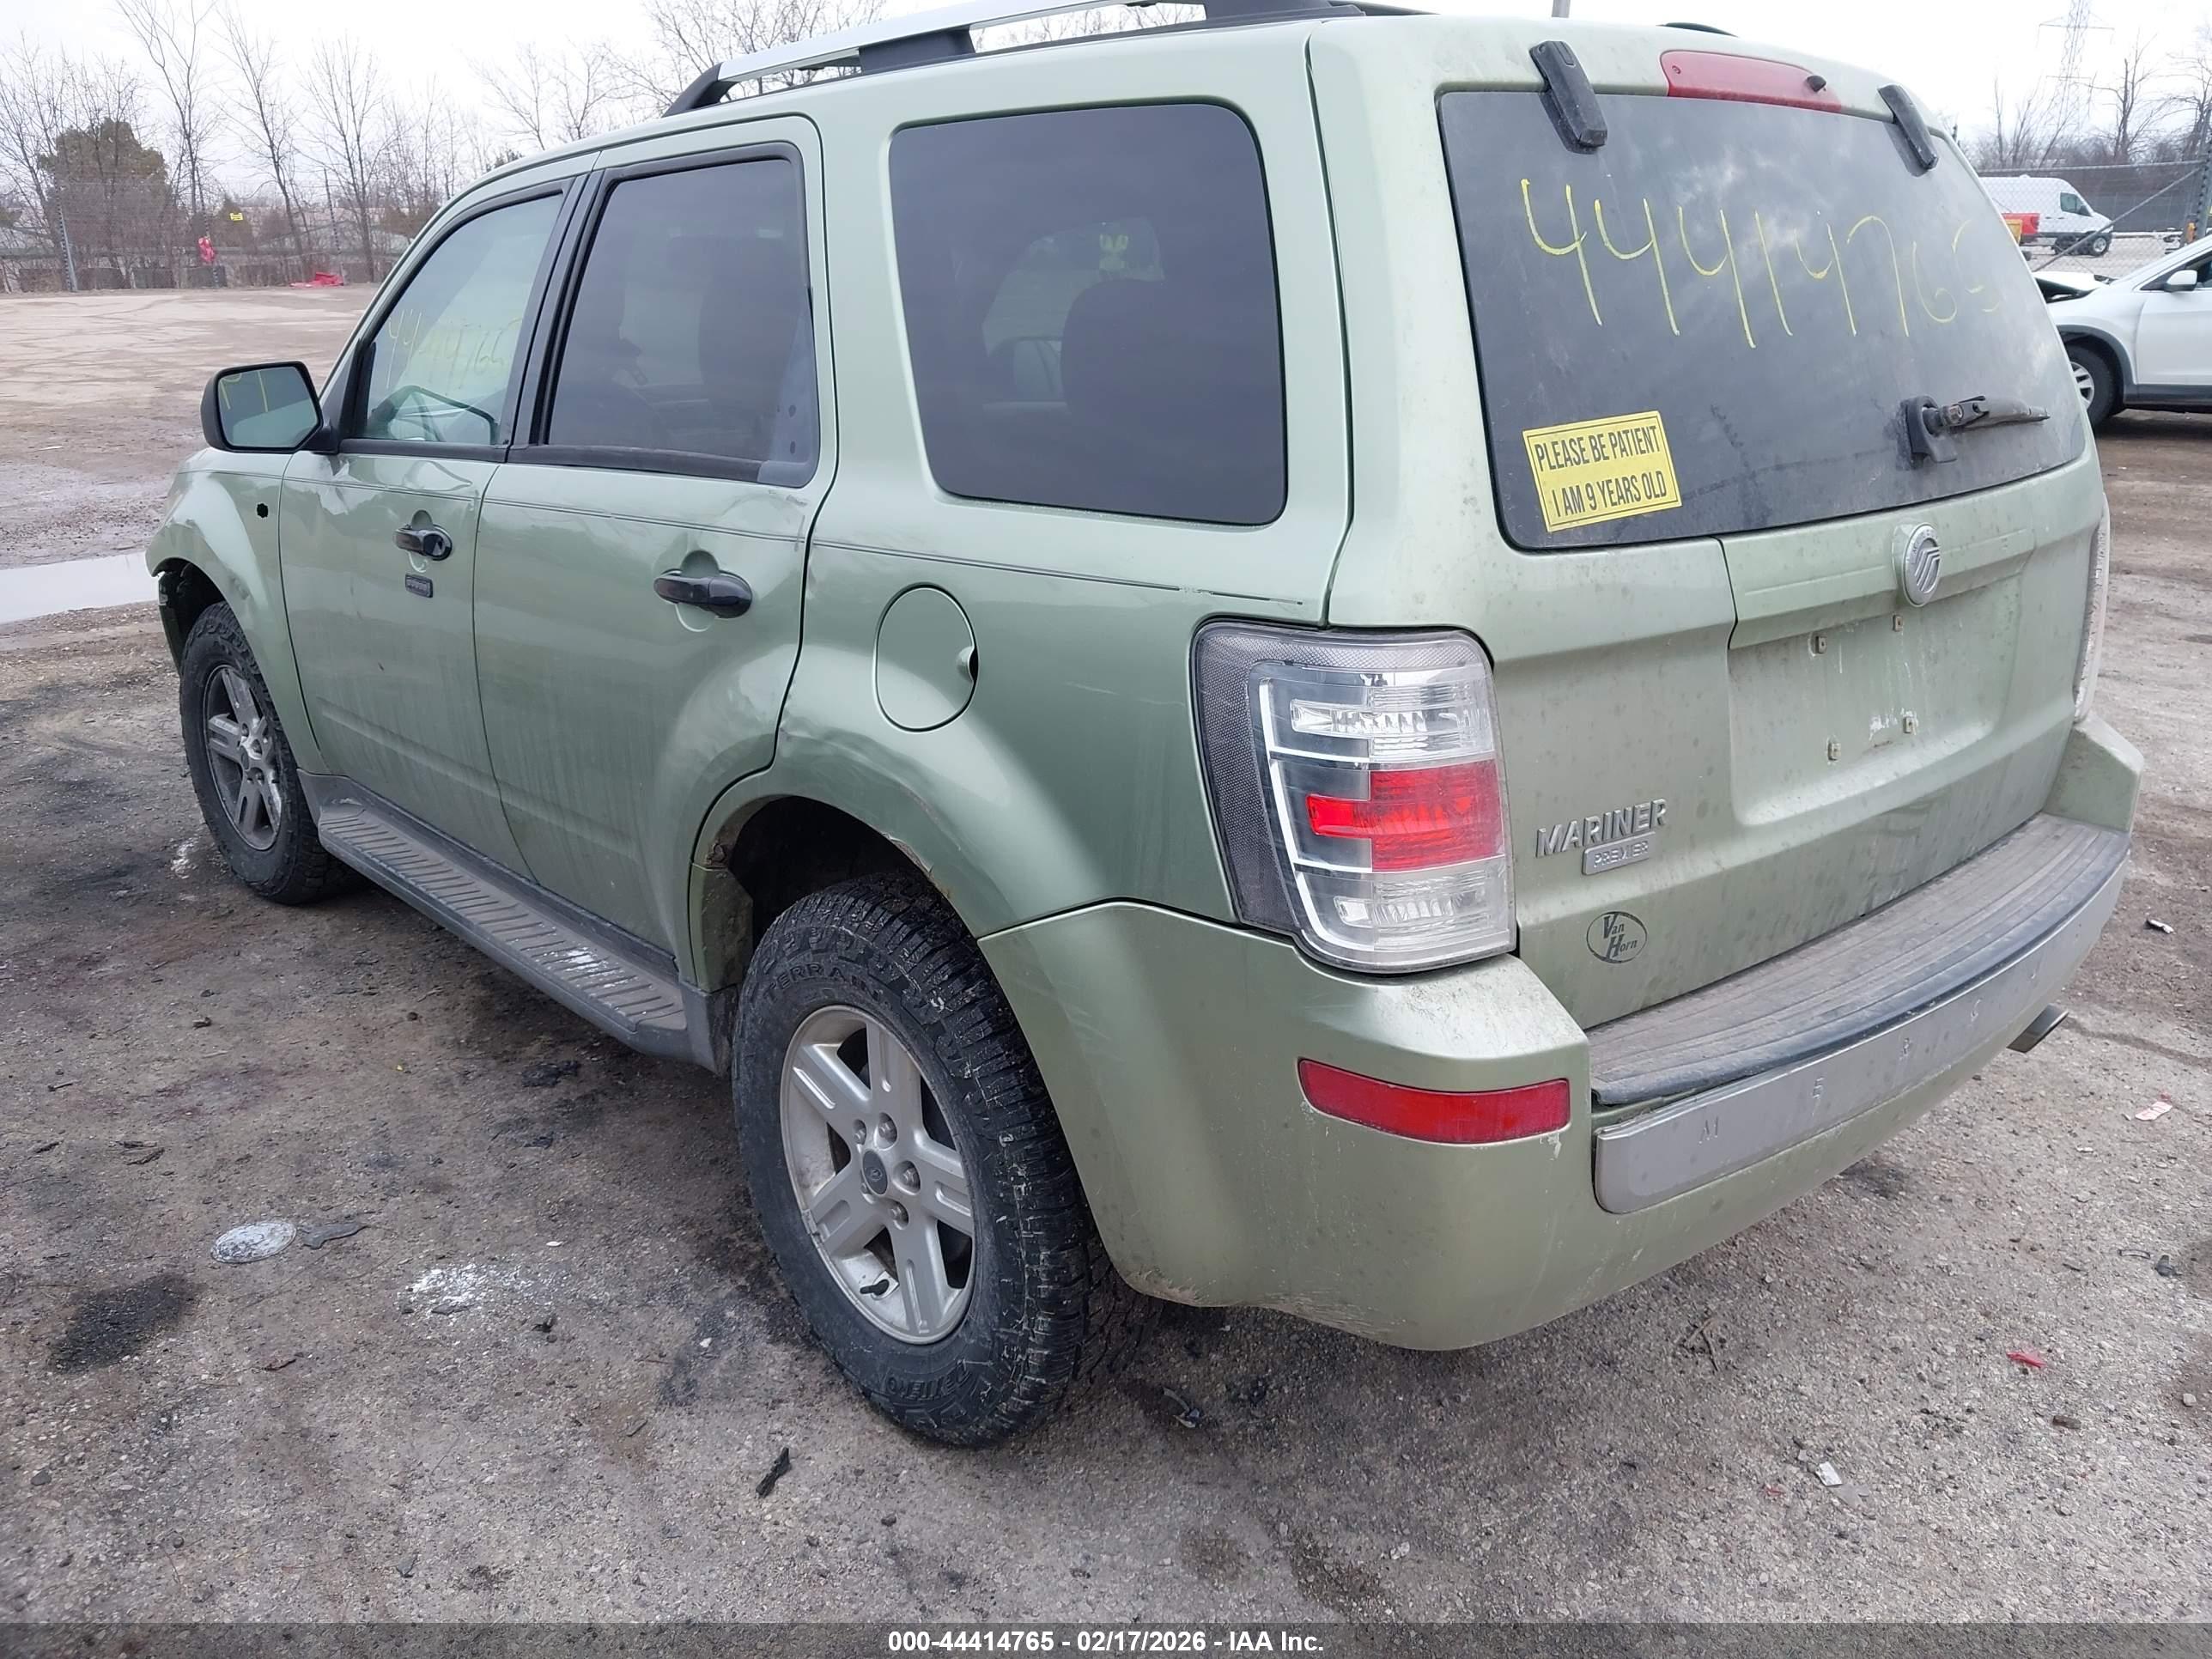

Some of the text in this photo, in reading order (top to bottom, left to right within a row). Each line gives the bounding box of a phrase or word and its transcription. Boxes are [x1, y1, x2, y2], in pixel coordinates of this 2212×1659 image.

[1534, 426, 1661, 471] PLEASE BE PATIENT
[1552, 471, 1667, 517] I AM 9 YEARS OLD
[1535, 798, 1668, 858] MARINER
[1602, 913, 1626, 939] Van
[1606, 933, 1638, 959] Horn
